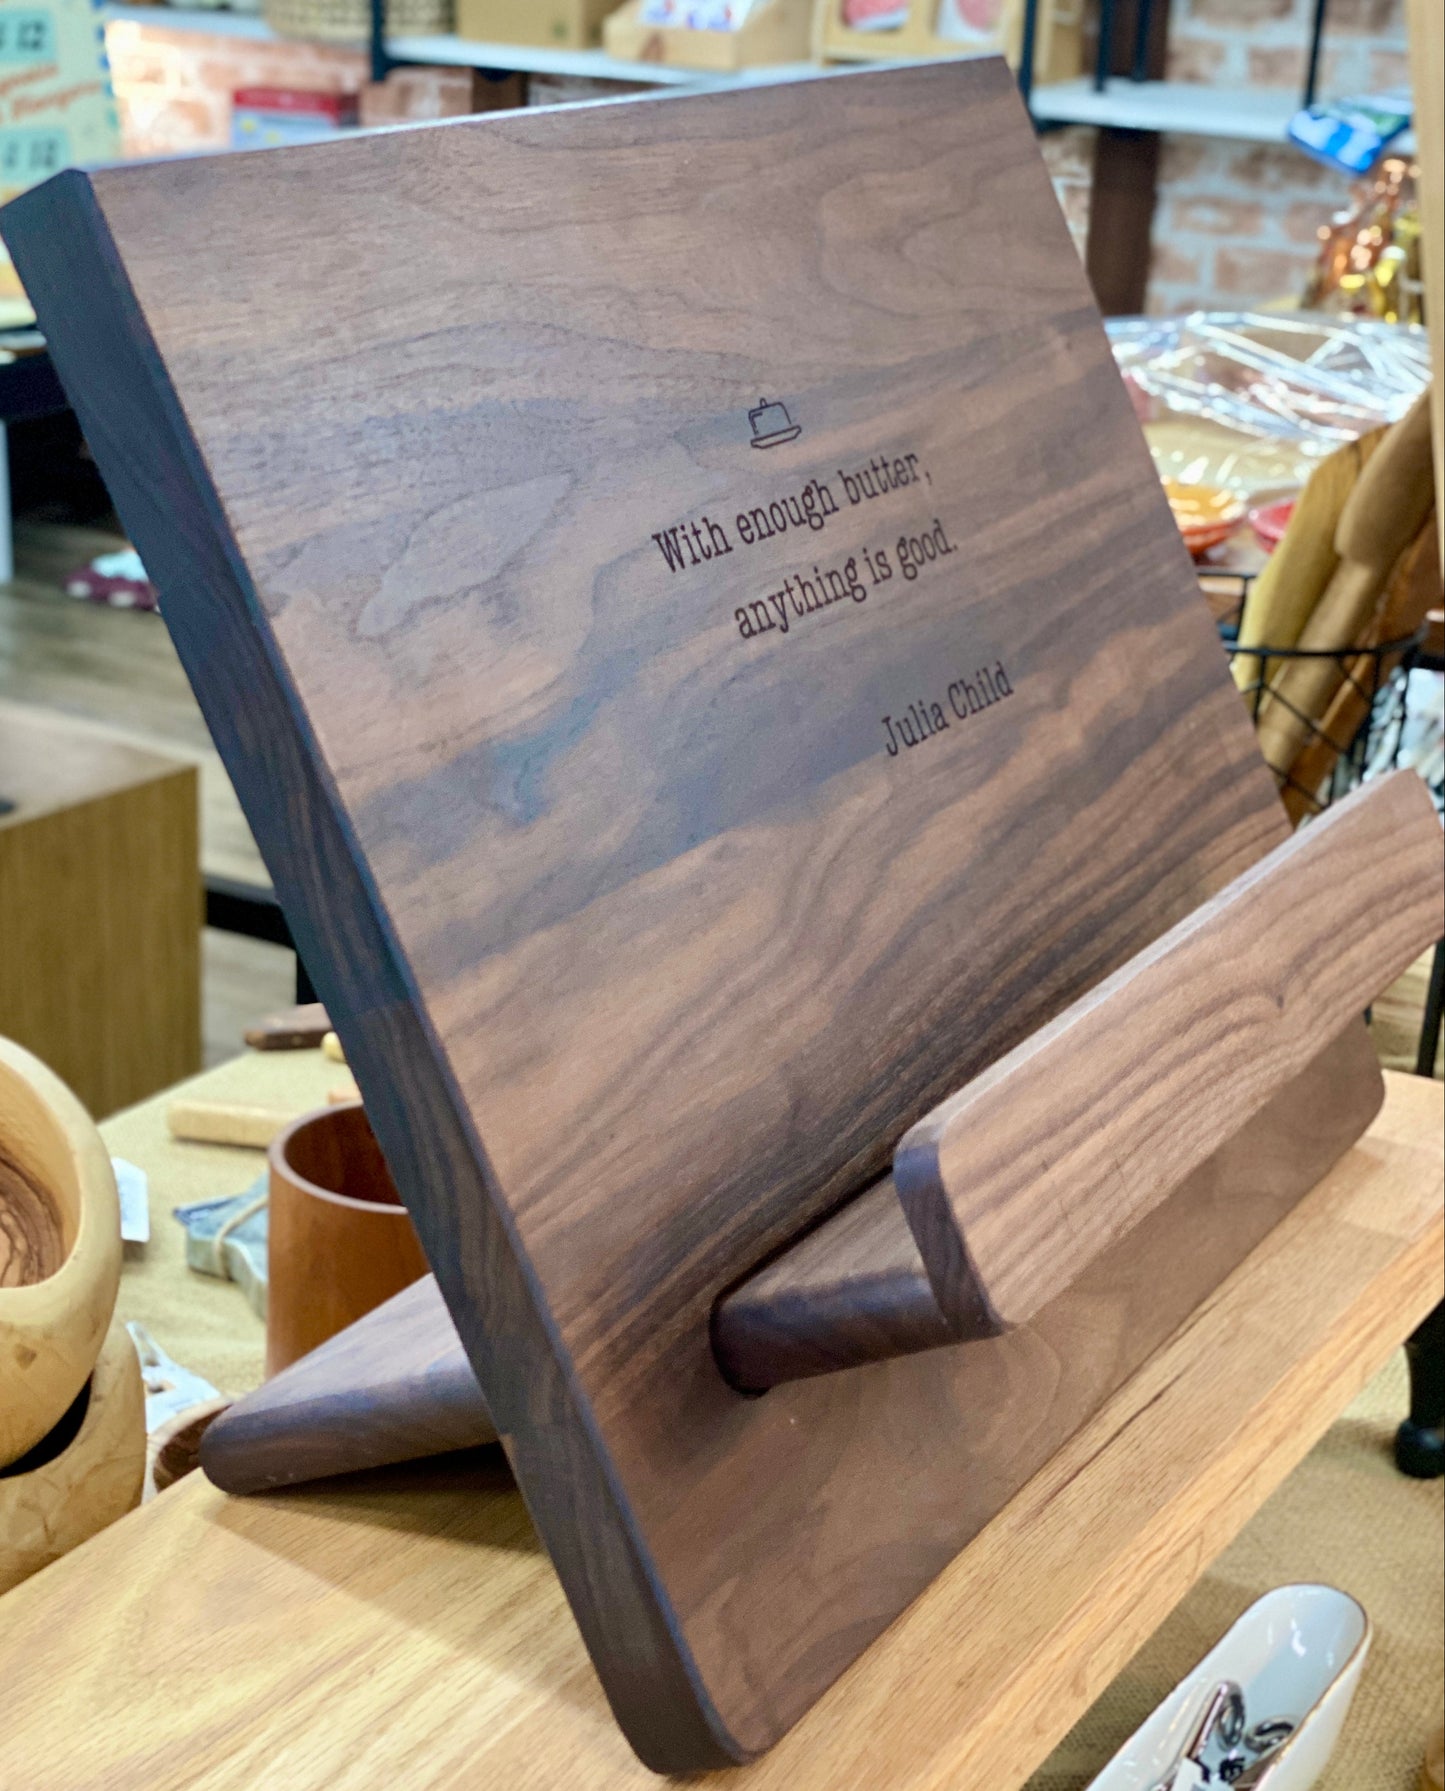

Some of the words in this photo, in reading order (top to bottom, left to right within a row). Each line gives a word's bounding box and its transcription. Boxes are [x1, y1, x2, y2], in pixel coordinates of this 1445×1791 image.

[651, 517, 734, 573] With
[735, 479, 840, 545] enough
[837, 452, 933, 505] butter,
[734, 557, 868, 639] anything
[862, 547, 893, 585] is
[895, 518, 959, 581] good.
[881, 700, 950, 757] Julia
[946, 660, 1014, 720] Child
